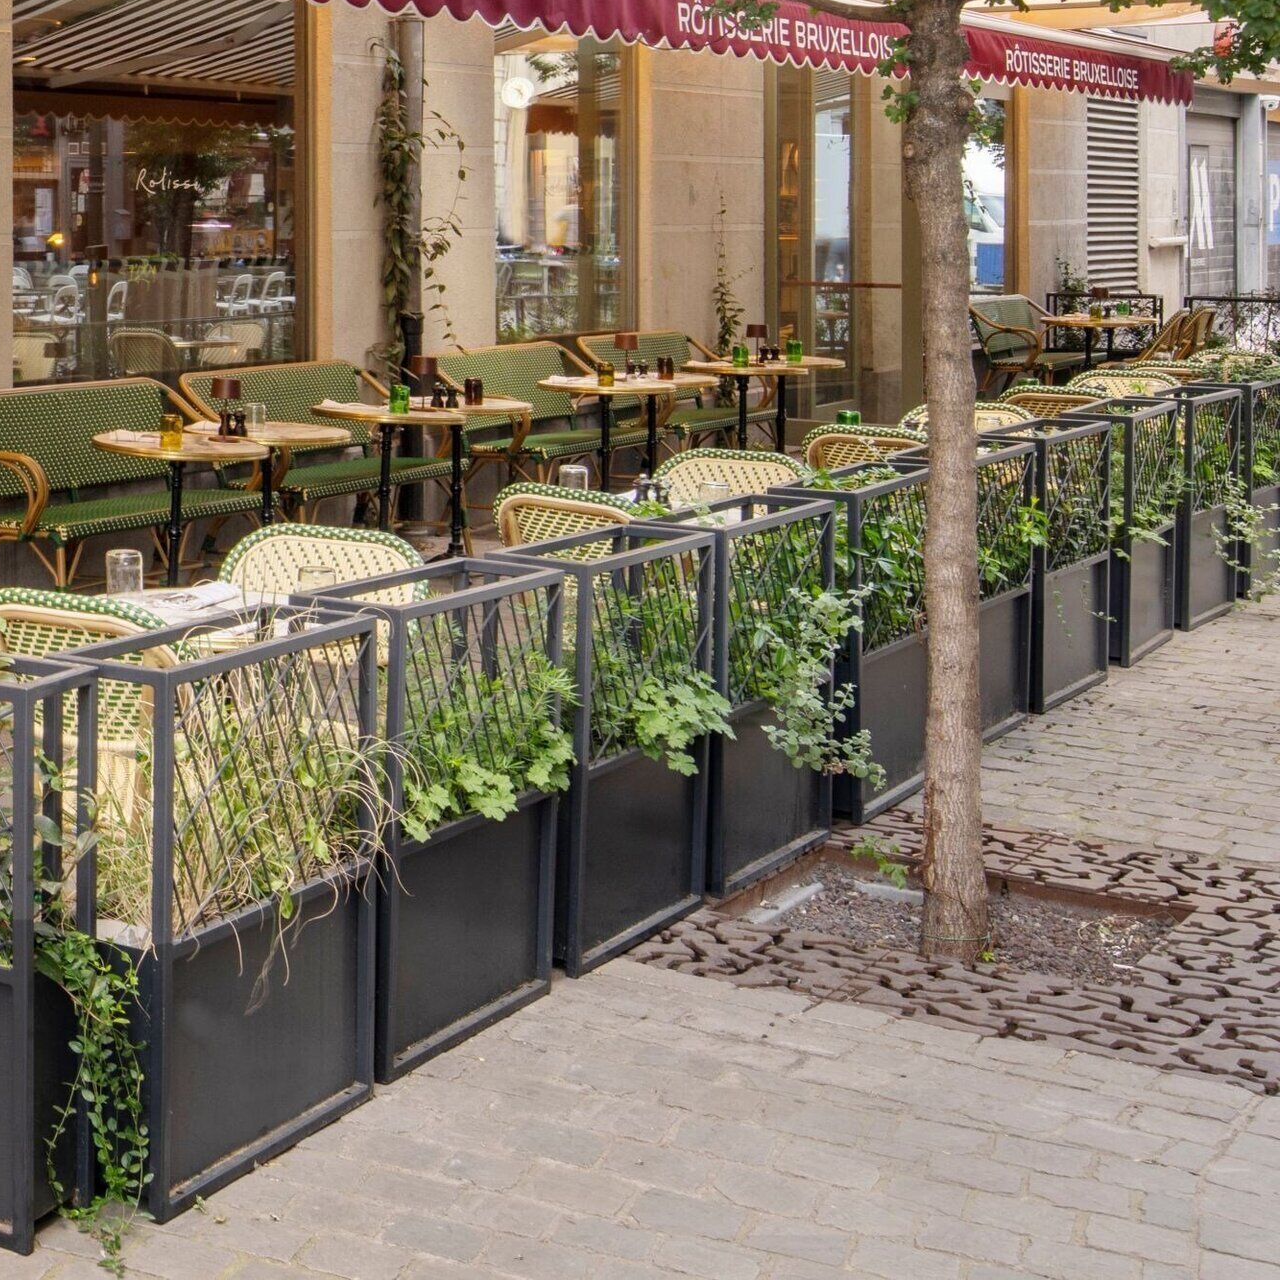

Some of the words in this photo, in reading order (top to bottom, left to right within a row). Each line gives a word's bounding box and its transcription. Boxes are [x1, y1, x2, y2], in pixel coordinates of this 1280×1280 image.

[795, 20, 899, 61] BRUXELLOIS
[1005, 43, 1071, 80] RÔTISSERIE
[1073, 59, 1139, 90] BRUXELLOISE
